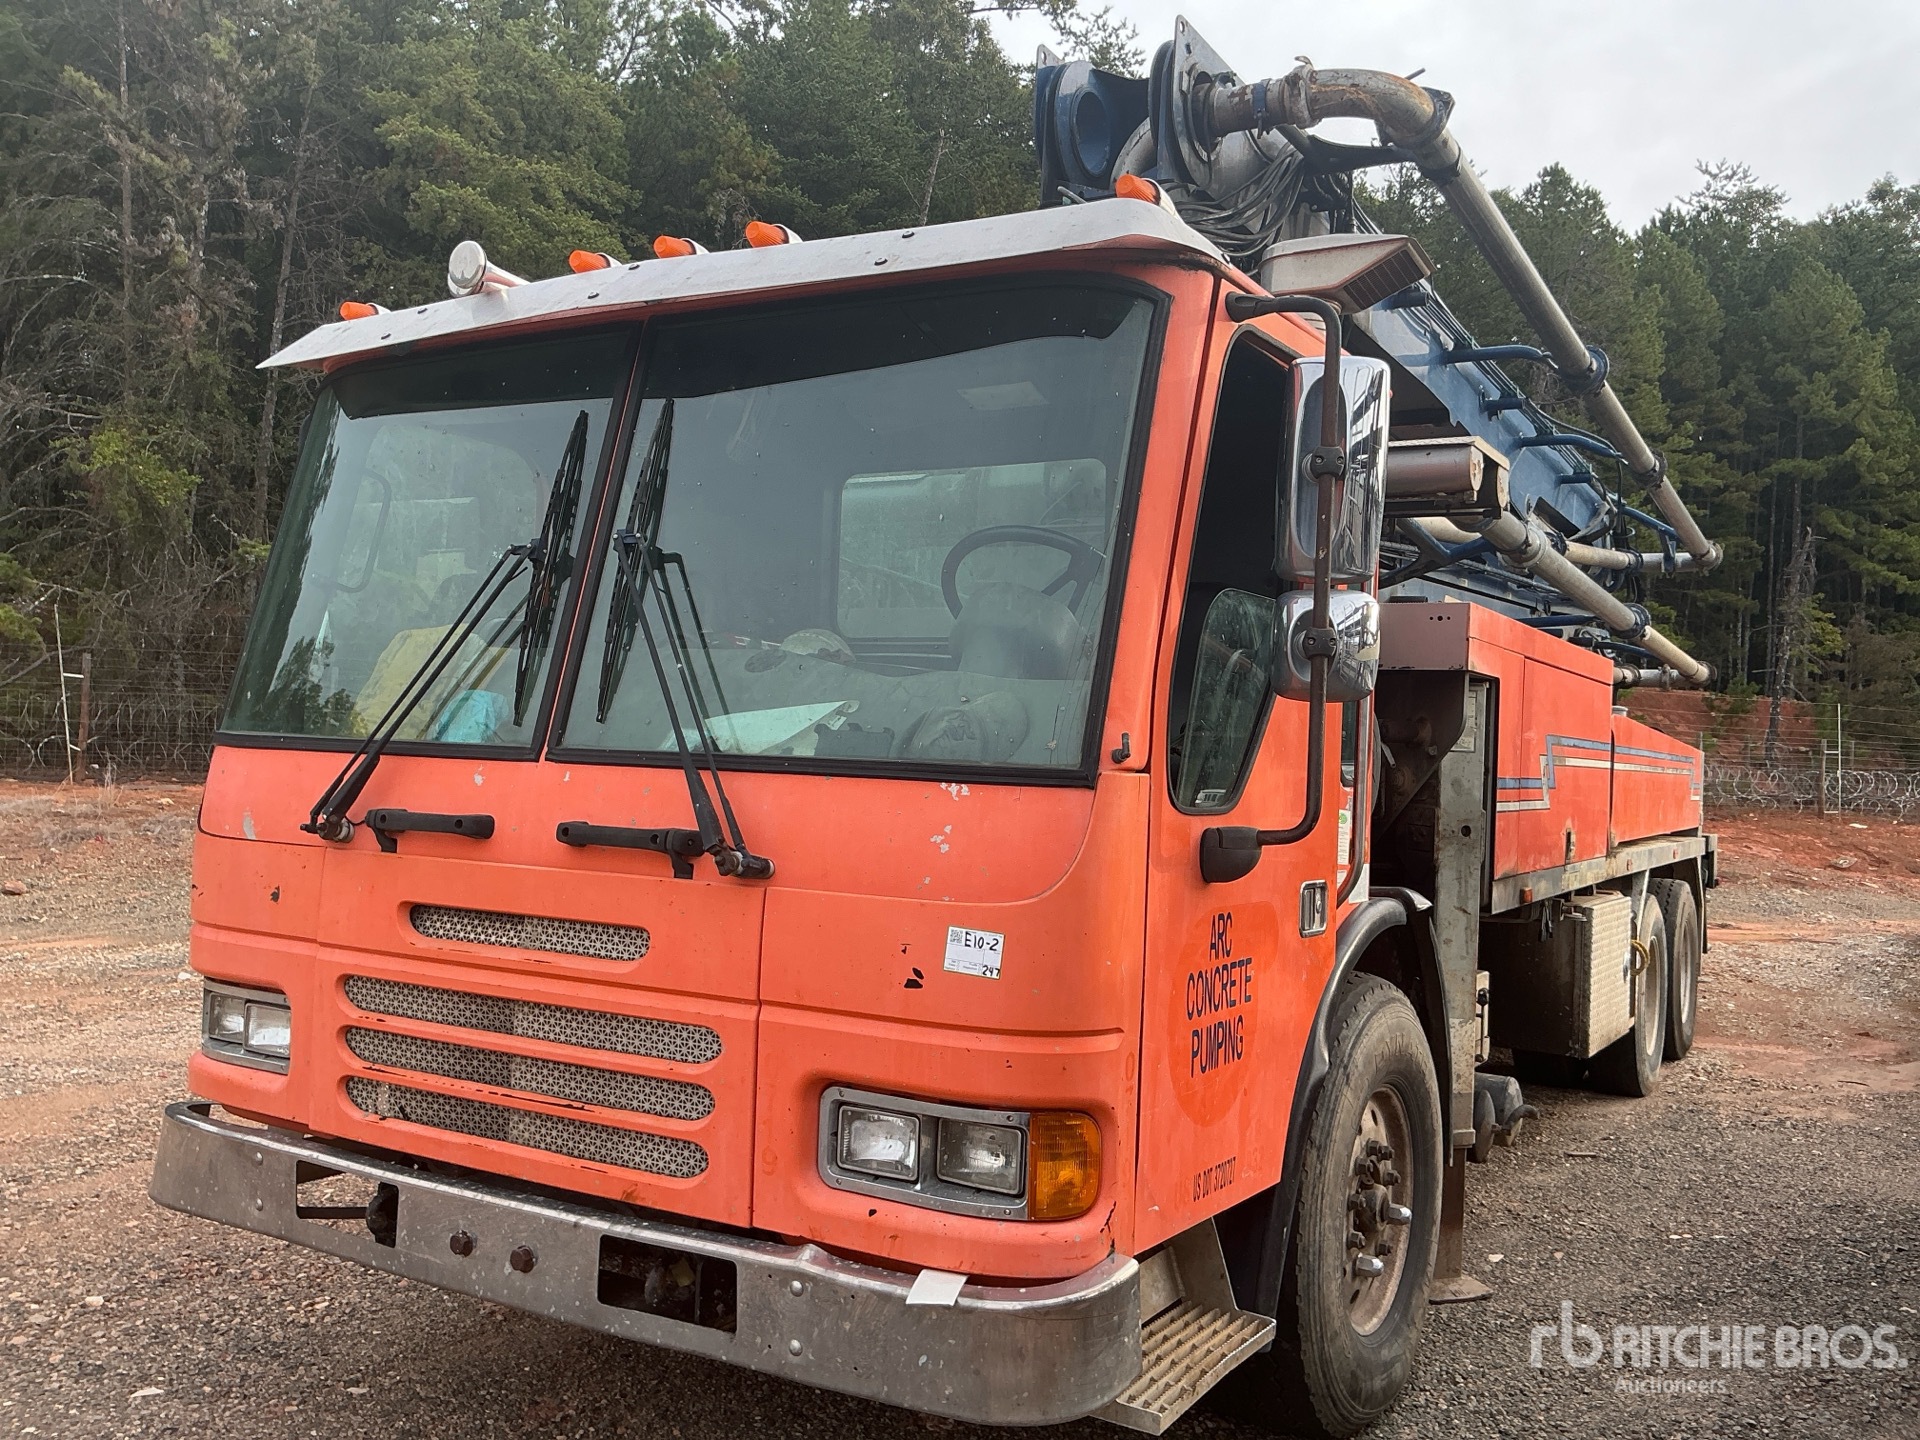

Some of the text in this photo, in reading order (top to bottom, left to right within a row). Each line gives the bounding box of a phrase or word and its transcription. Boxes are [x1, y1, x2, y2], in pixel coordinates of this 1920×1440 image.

[964, 931, 999, 951] E10-2
[1209, 911, 1233, 962] ARC
[1187, 957, 1253, 1021] CONCRETE
[1191, 1014, 1244, 1079] PUMPING
[1193, 1172, 1202, 1203] US
[1202, 1167, 1213, 1199] DOT
